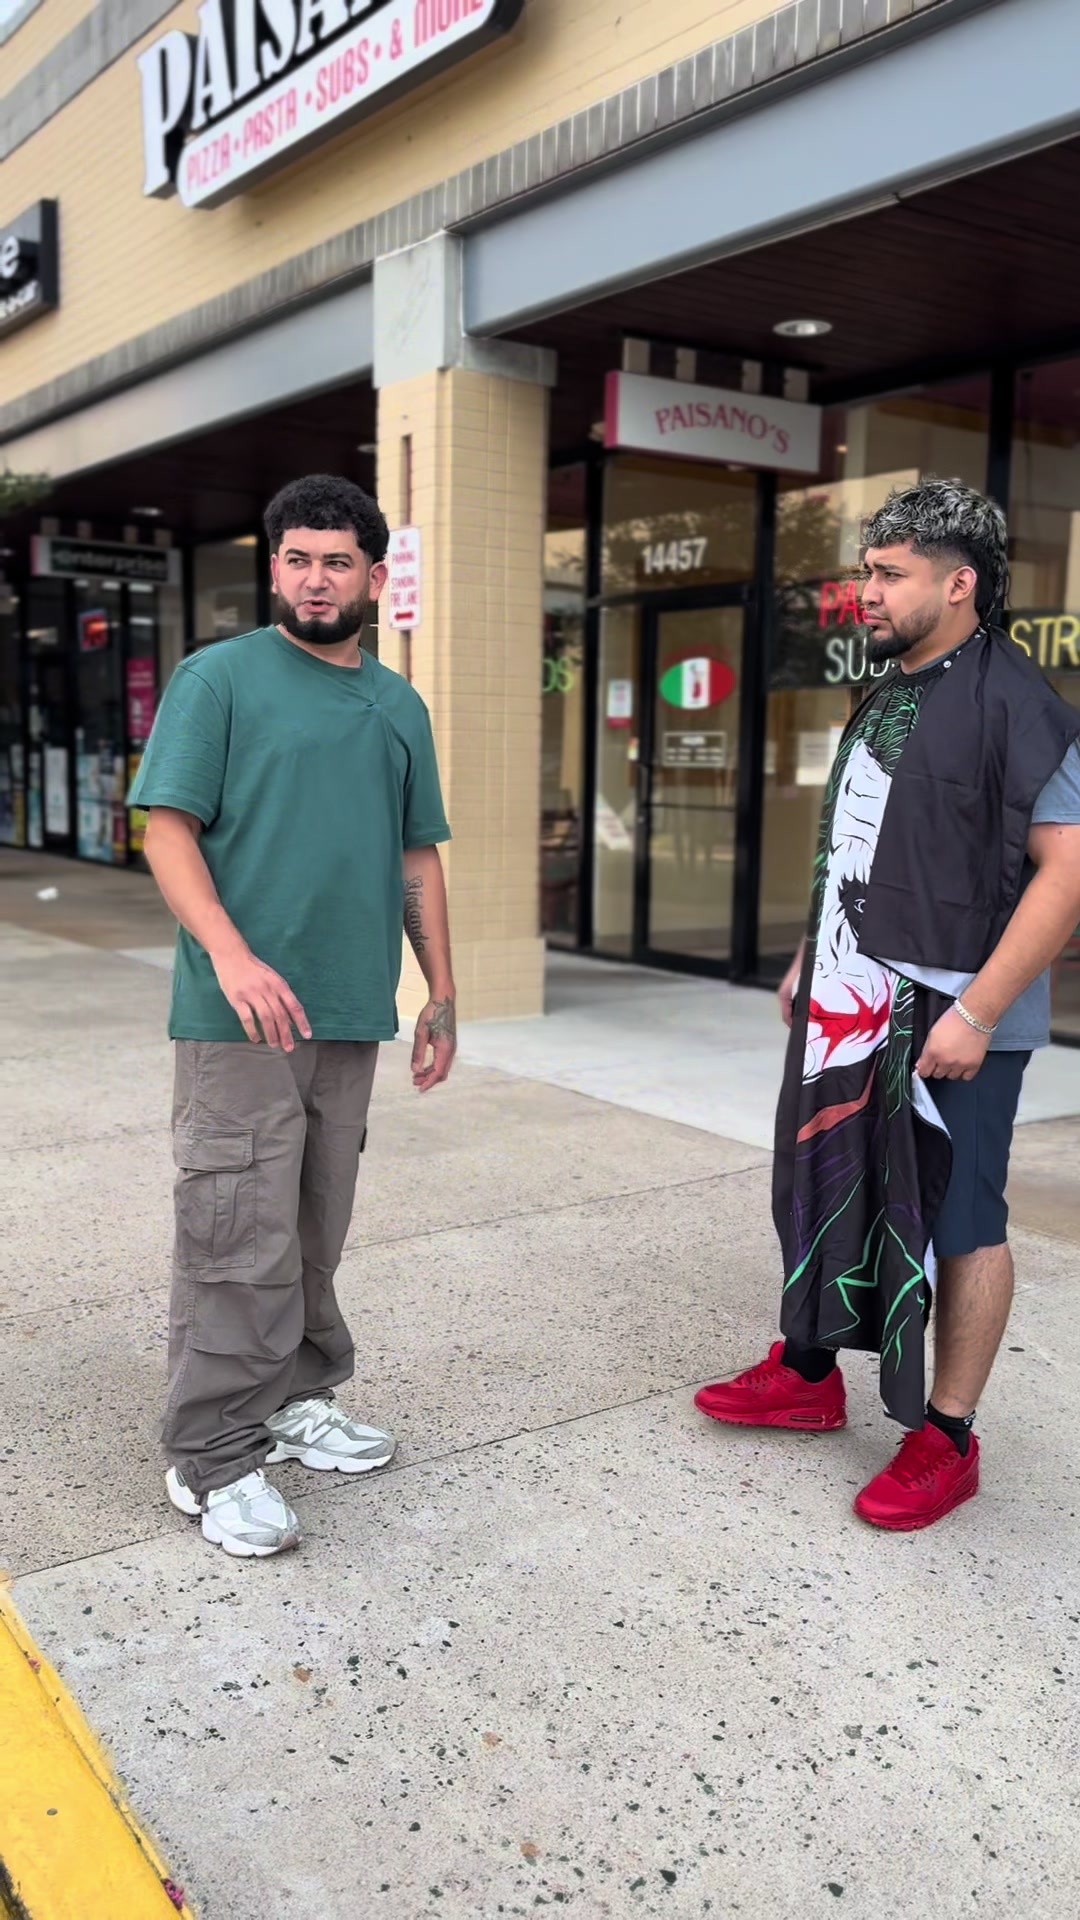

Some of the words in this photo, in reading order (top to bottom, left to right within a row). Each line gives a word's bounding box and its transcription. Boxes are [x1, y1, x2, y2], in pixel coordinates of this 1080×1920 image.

[136, 0, 372, 197] PAIS
[186, 131, 231, 191] PIZZA
[242, 86, 298, 161] PASTA
[315, 37, 369, 112] SUBS
[414, 0, 483, 49] MO
[654, 402, 790, 454] PAISANO'S
[642, 537, 708, 574] 14457
